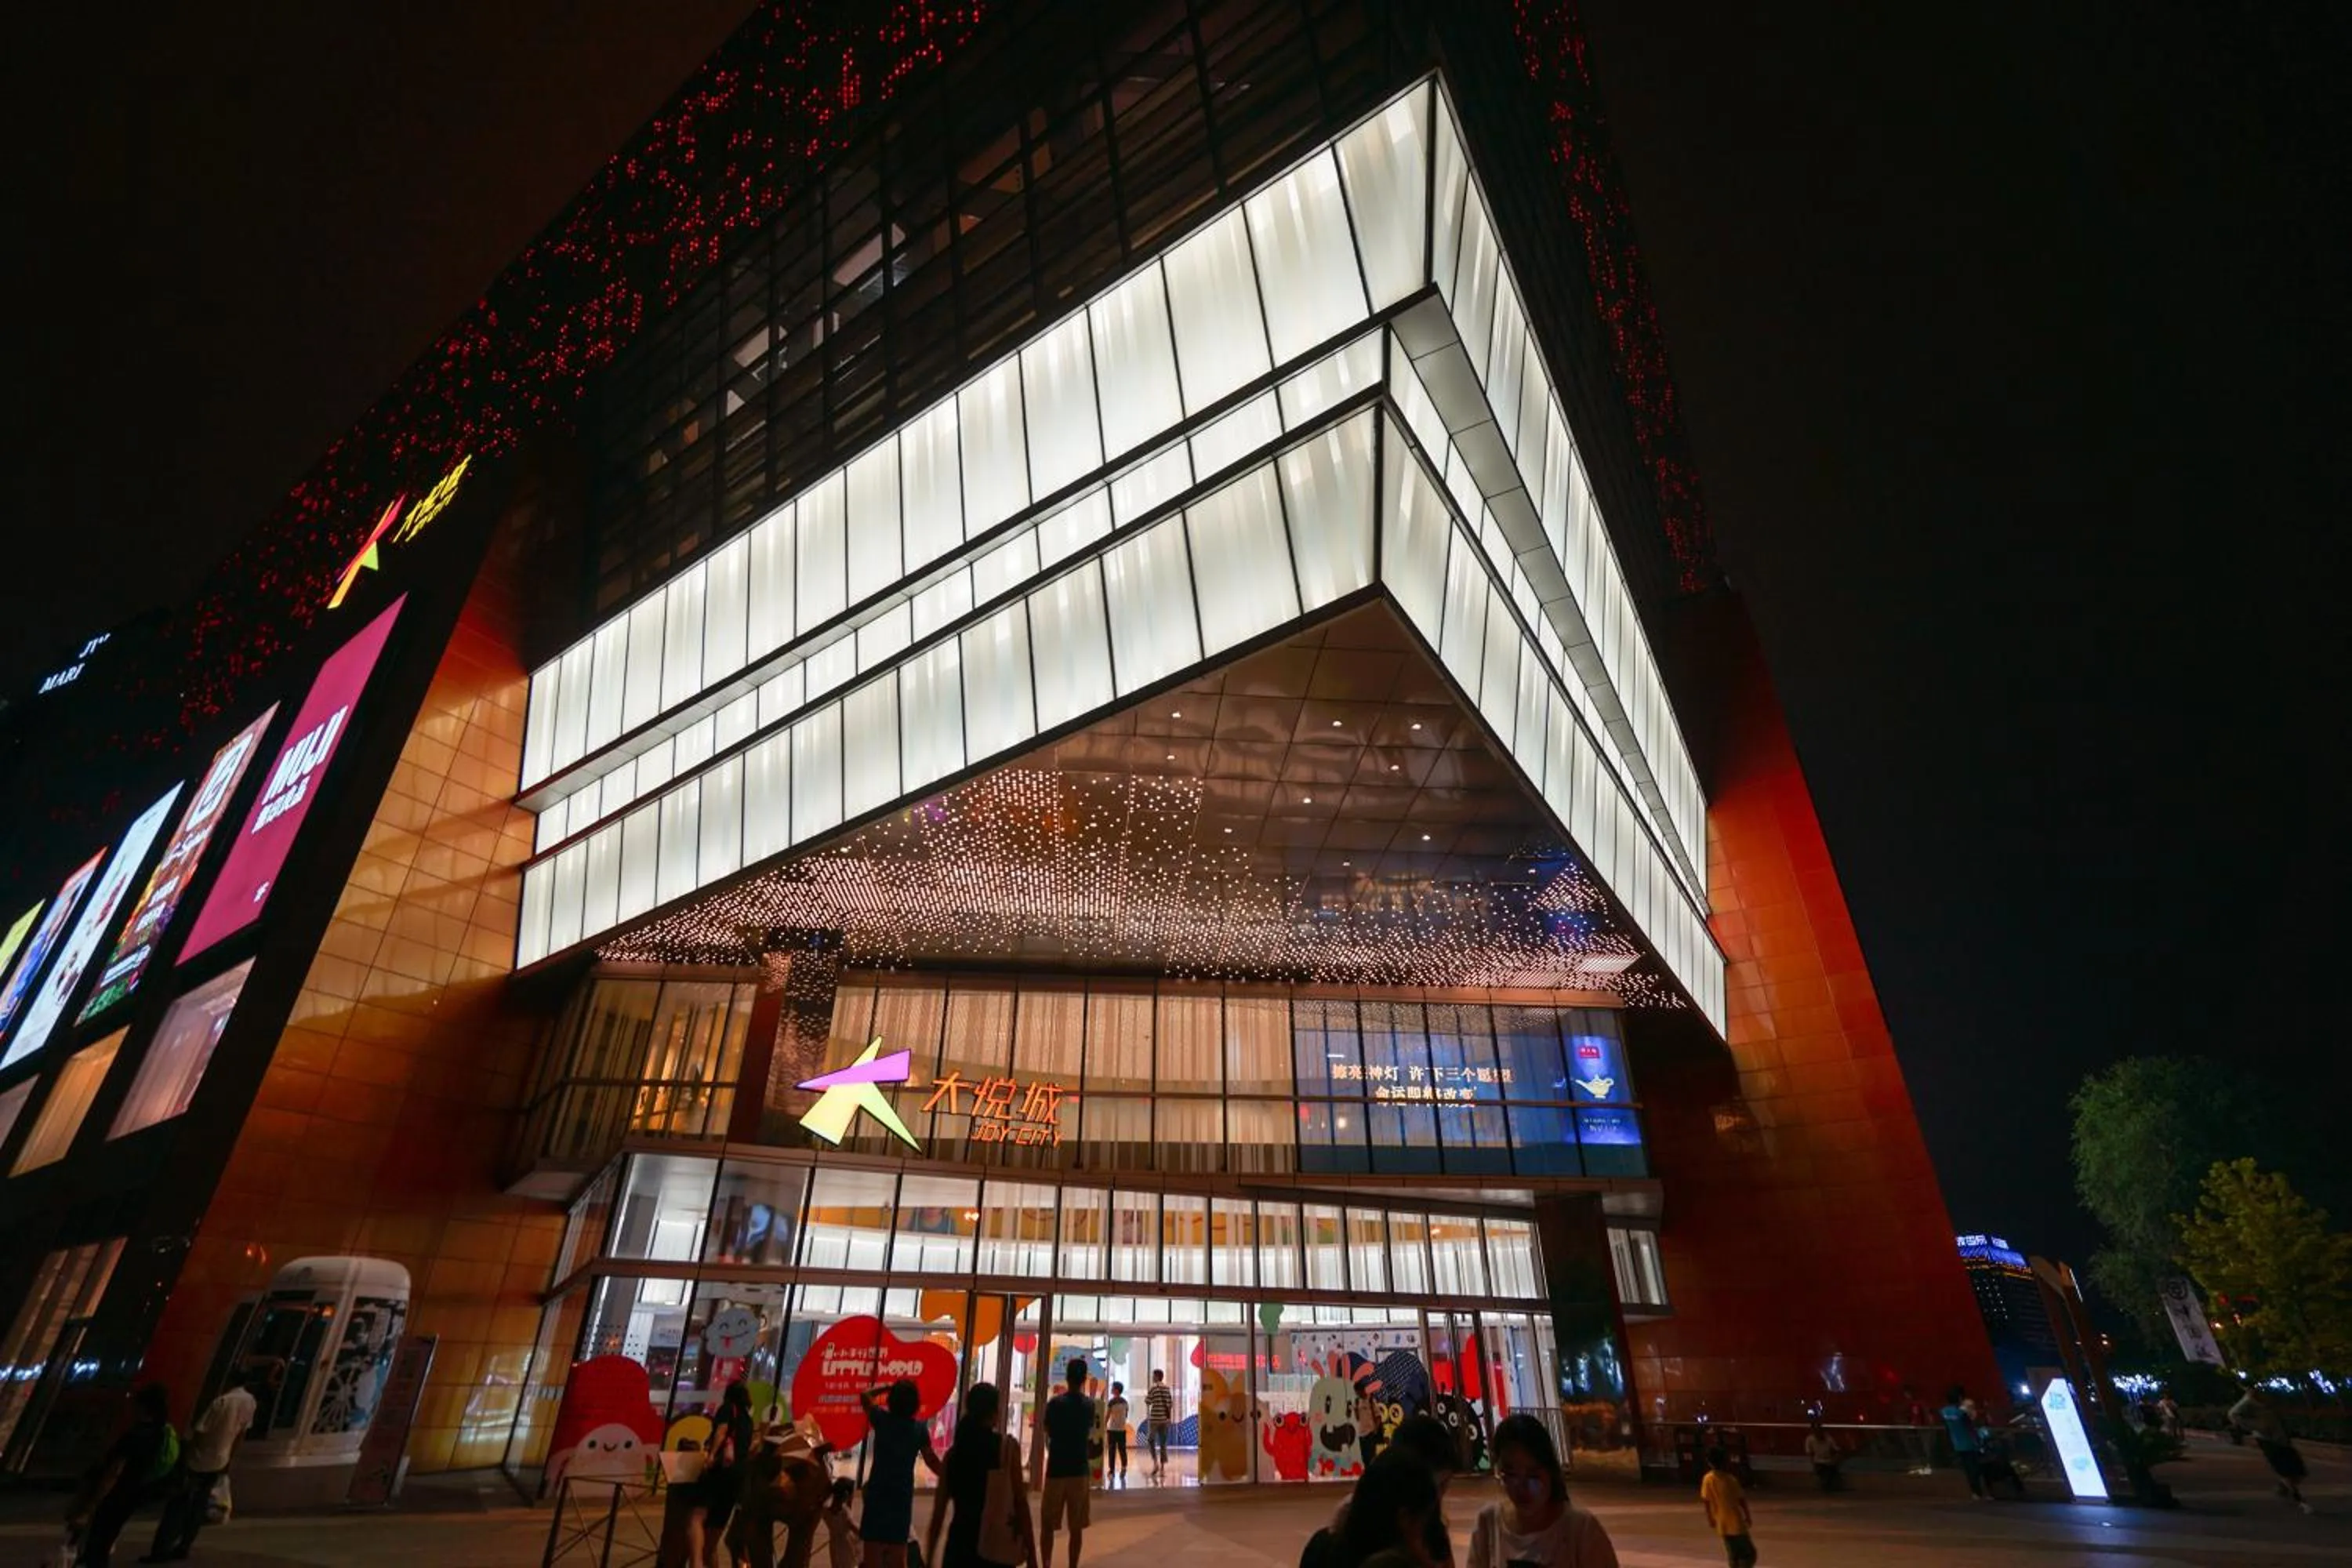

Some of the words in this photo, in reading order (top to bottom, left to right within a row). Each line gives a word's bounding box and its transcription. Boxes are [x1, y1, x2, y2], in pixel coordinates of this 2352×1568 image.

[261, 706, 348, 806] MUJI
[921, 1071, 1064, 1124] 大悦城
[972, 1122, 1011, 1143] JOY
[1015, 1126, 1065, 1149] CITY
[877, 1359, 924, 1377] WORLD
